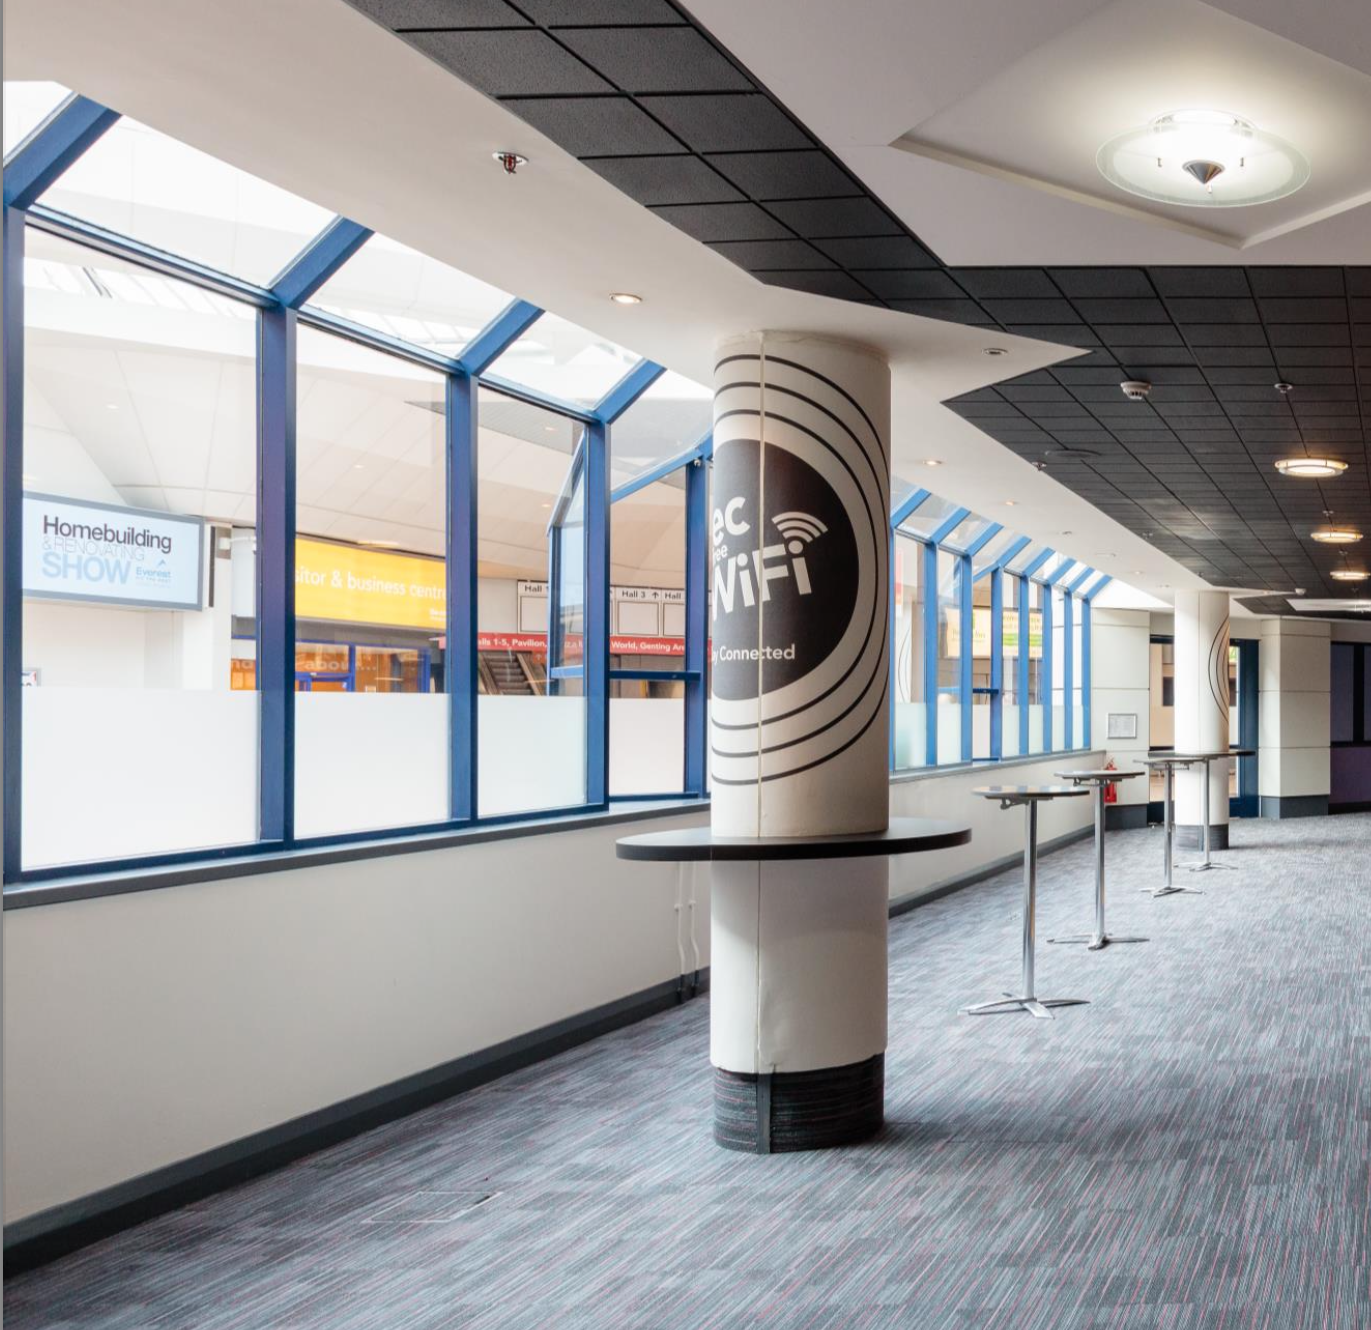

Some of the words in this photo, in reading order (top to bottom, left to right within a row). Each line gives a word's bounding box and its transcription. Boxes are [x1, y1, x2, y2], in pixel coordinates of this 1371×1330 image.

[43, 514, 172, 554] Homebuilding
[54, 537, 145, 562] RENOVATING
[42, 551, 131, 585] SHOW
[330, 570, 343, 588] &
[347, 571, 406, 596] business
[524, 584, 542, 592] Hall
[622, 590, 638, 598] Hall
[640, 591, 646, 599] 3
[664, 591, 681, 599] Hall
[611, 641, 638, 650] World,
[640, 642, 671, 652] Genting
[719, 644, 795, 662] Connected
